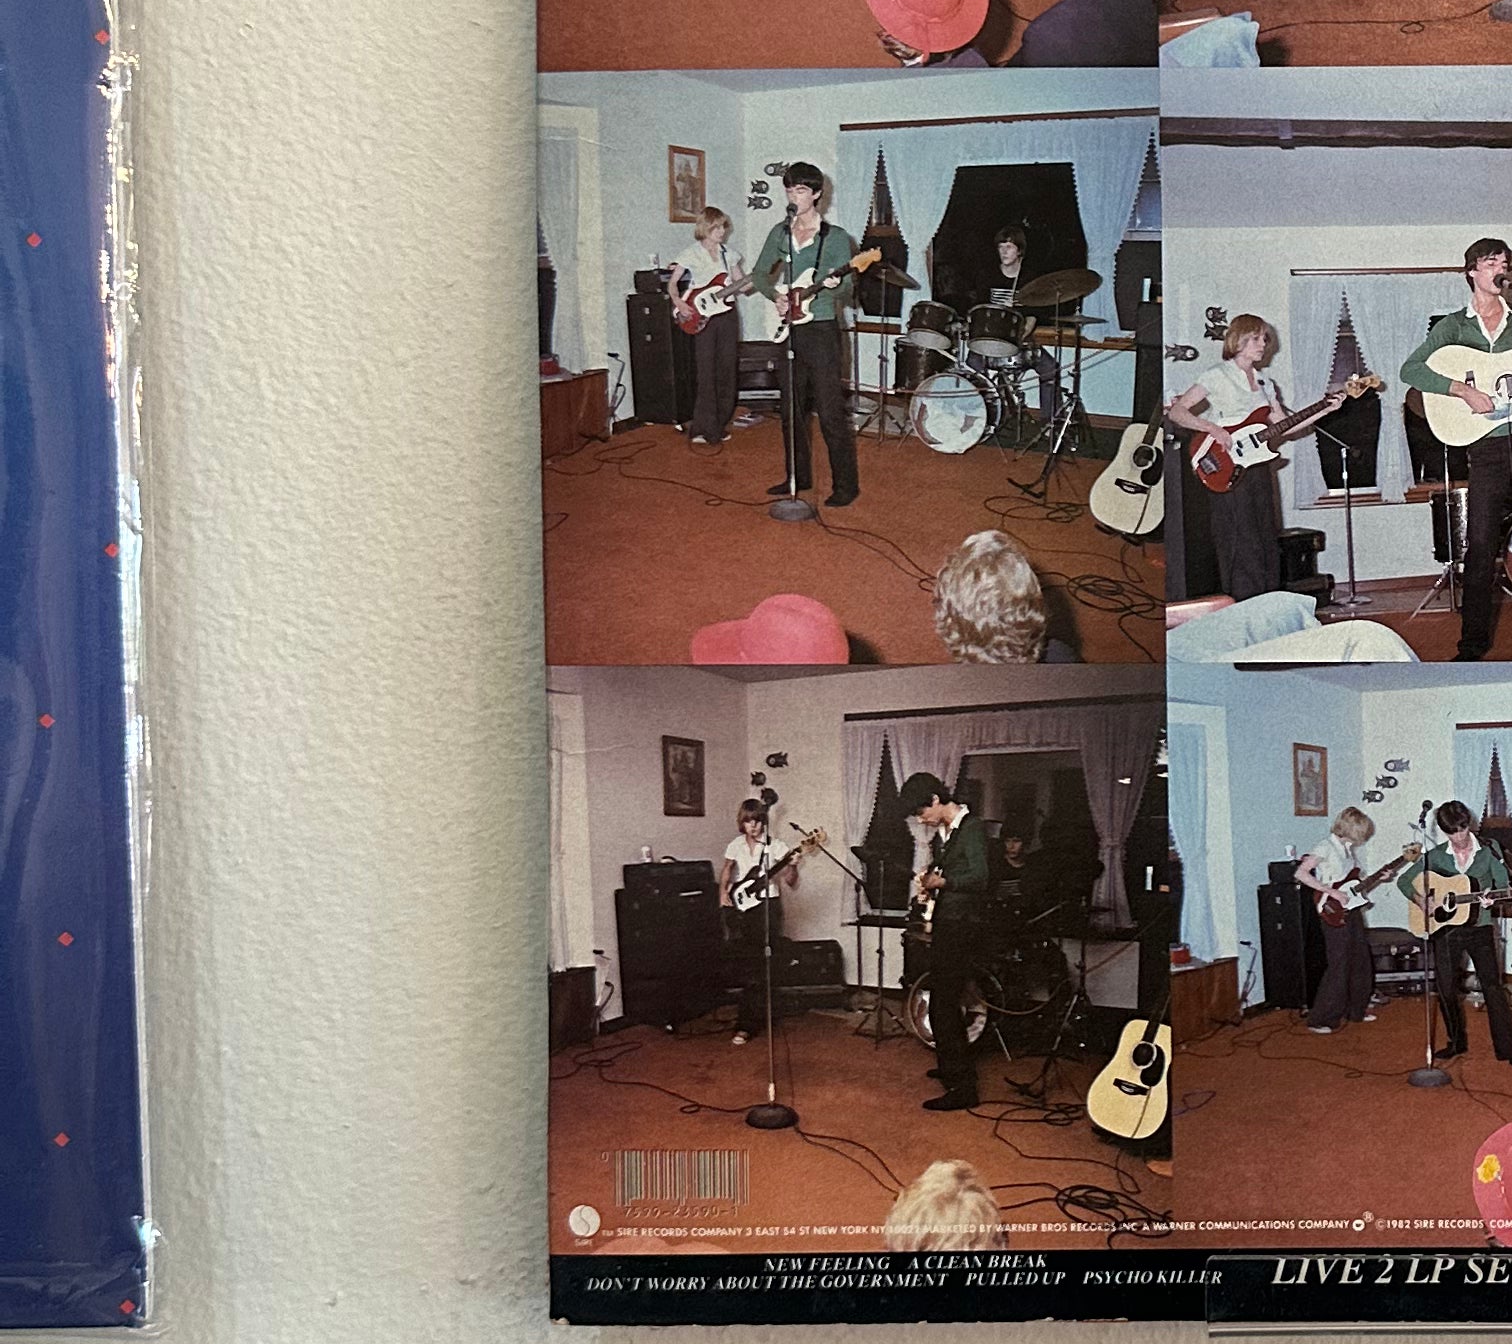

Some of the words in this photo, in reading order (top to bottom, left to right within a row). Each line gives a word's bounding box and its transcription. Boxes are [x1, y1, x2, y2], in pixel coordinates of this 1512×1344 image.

[616, 1228, 638, 1236] SIRE
[641, 1227, 688, 1236] RECORDS
[690, 1227, 741, 1236] COMPANY
[755, 1226, 780, 1236] EAST
[799, 1226, 811, 1235] ST
[813, 1226, 838, 1235] NEW
[841, 1225, 868, 1235] YORK
[871, 1225, 885, 1235] NY
[979, 1224, 993, 1233] BY
[995, 1223, 1038, 1233] WARNER
[1041, 1223, 1067, 1232] BROS
[1070, 1222, 1116, 1232] RECORDS
[1152, 1221, 1196, 1231] WARNER
[1199, 1220, 1296, 1231] COMMUNICATIONS
[1298, 1220, 1350, 1229] COMPANY
[1414, 1219, 1435, 1229] SIRE
[1438, 1219, 1484, 1229] RECORDS
[764, 1257, 806, 1272] NEW
[809, 1256, 890, 1271] FEELING
[907, 1256, 919, 1270] A
[924, 1255, 983, 1269] CLEAN
[988, 1254, 1047, 1269] BREAK
[1272, 1254, 1365, 1284] LIVE
[1375, 1254, 1394, 1284] 2
[1405, 1254, 1456, 1284] LP
[587, 1277, 644, 1291] DON'T
[649, 1276, 710, 1291] WORRY
[714, 1275, 776, 1290] ABOUT
[780, 1275, 820, 1289] THE
[821, 1274, 949, 1288] GOVERNMENT
[965, 1271, 1038, 1286] PULLED
[1042, 1271, 1066, 1285] UP
[1082, 1270, 1153, 1285] PSYCHO
[1156, 1270, 1223, 1285] KILLER
